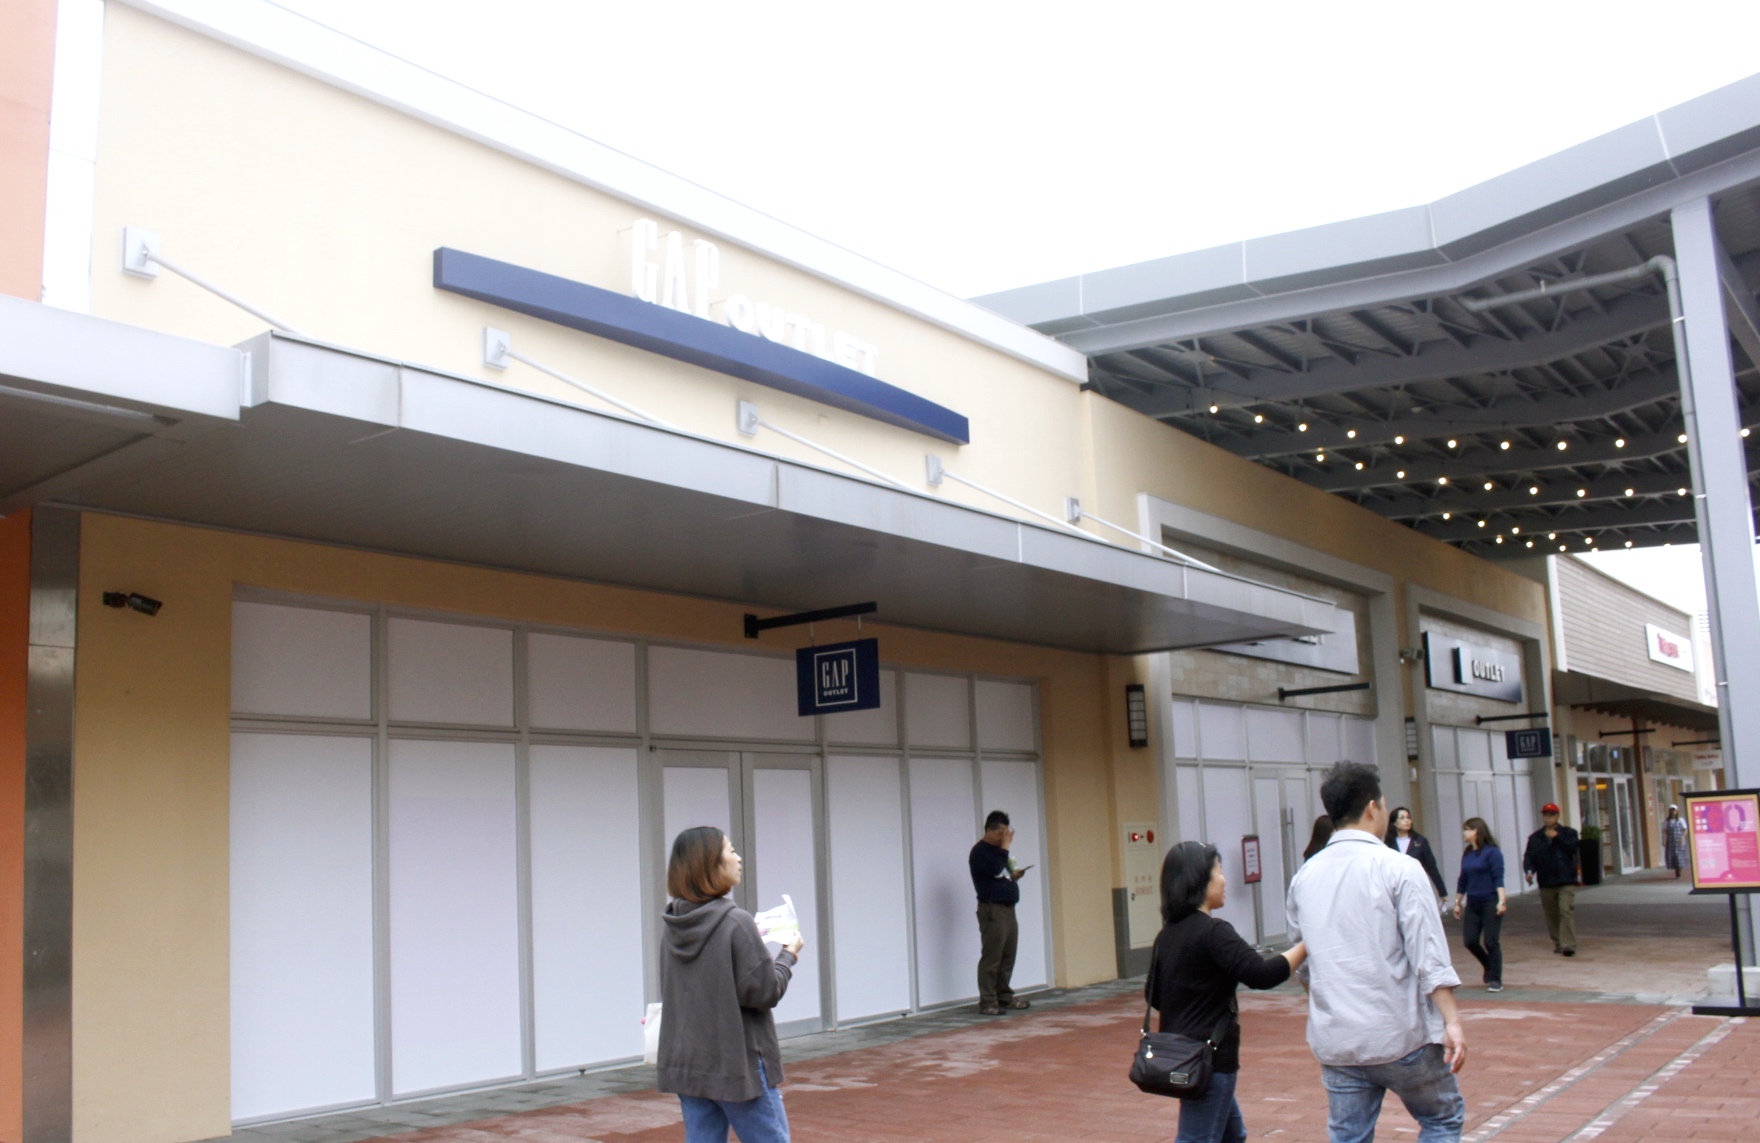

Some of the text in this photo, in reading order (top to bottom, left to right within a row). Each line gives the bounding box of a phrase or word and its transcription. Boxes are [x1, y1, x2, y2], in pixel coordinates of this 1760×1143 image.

[632, 218, 879, 377] GAP OUTLET
[822, 659, 849, 688] GAP
[1473, 660, 1505, 682] OUTLET
[823, 688, 849, 697] OUTLET
[1519, 735, 1536, 749] GAP
